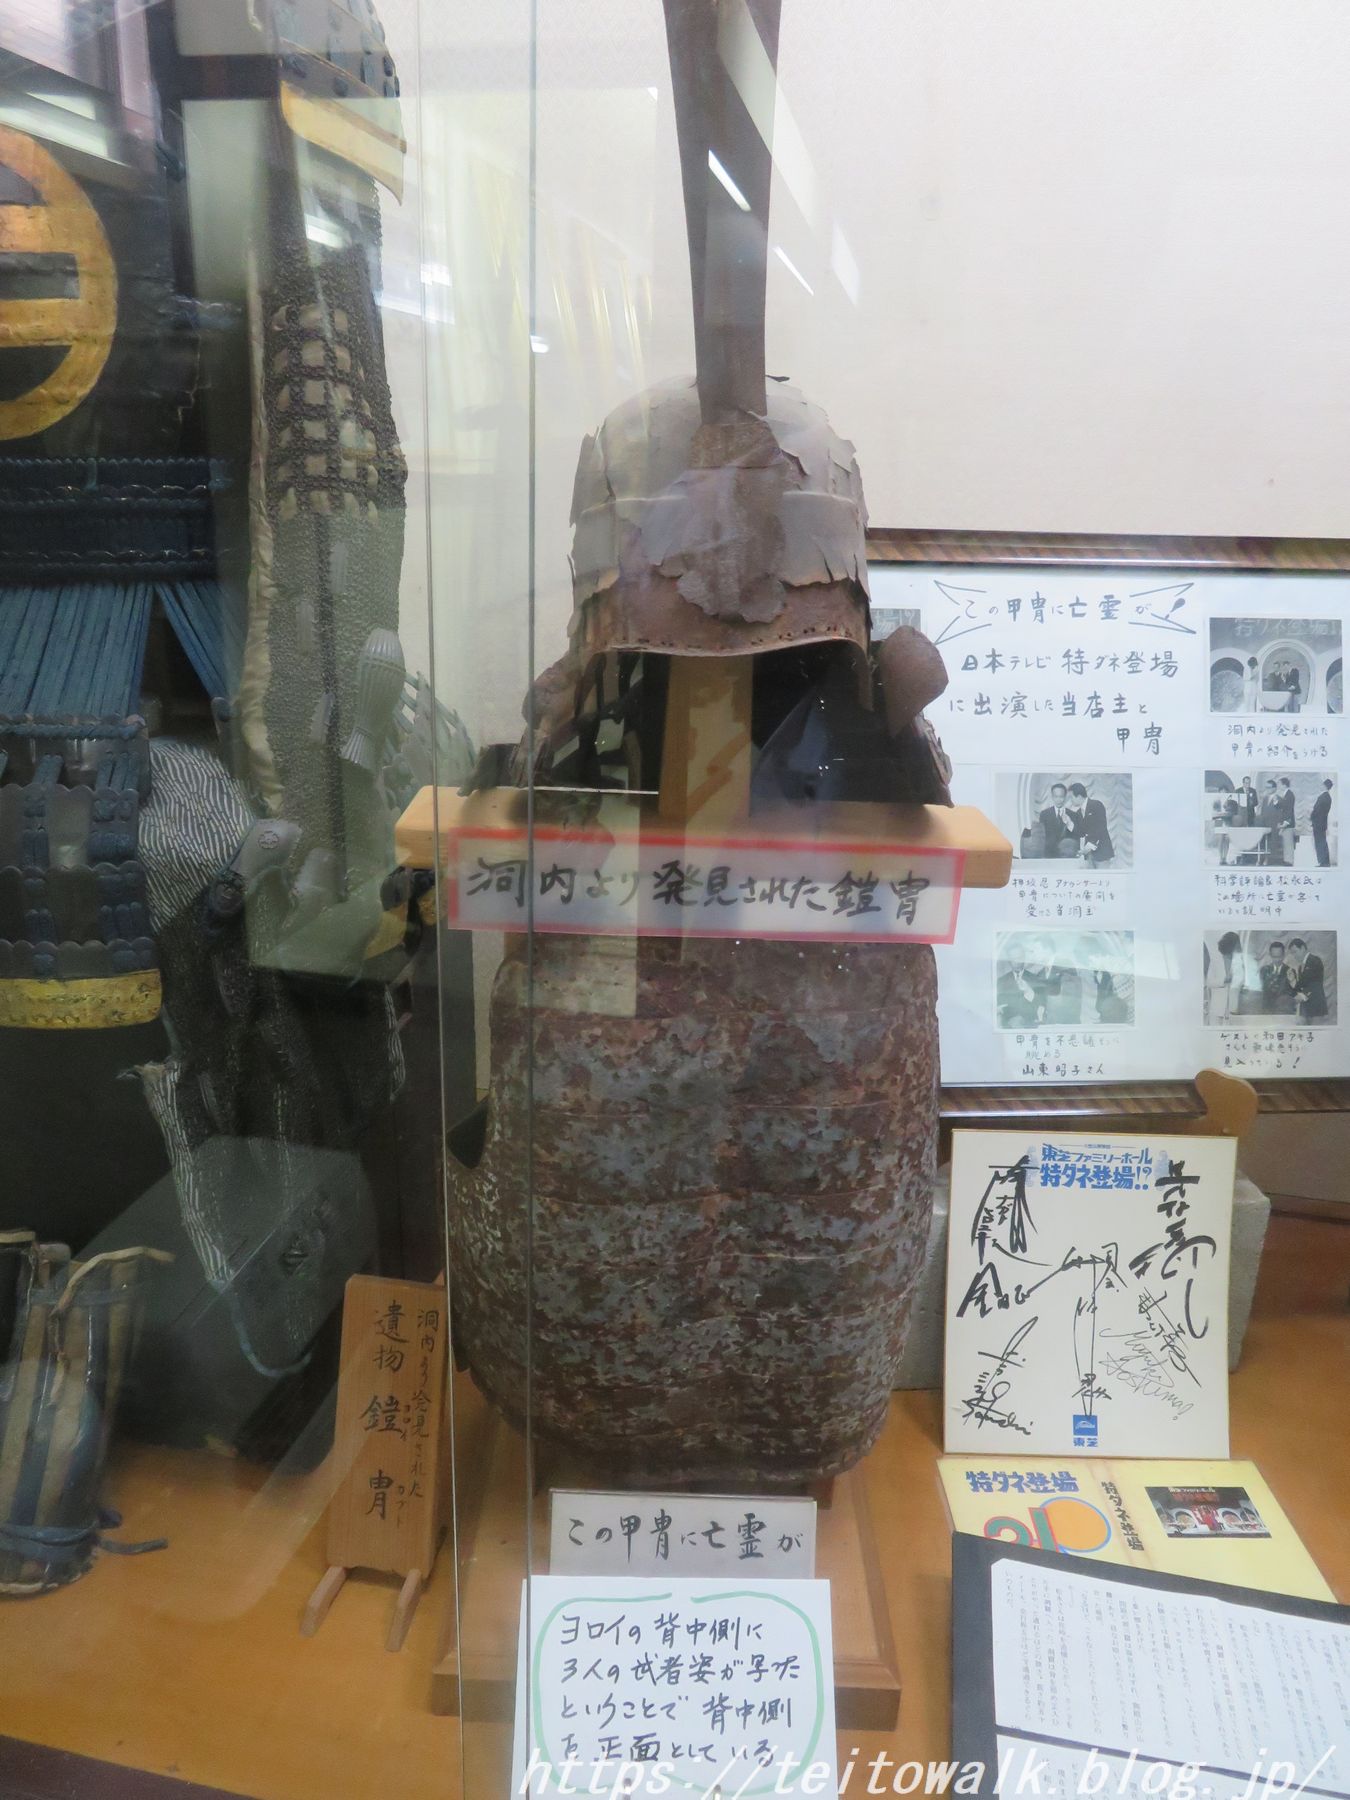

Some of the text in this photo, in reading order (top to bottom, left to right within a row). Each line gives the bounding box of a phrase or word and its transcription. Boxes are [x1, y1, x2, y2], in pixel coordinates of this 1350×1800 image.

[1115, 721, 1164, 756] 甲冑
[1041, 1143, 1153, 1165] 東芝ファミリーホール
[1040, 1163, 1153, 1190] 特ダネ登場!?
[567, 1508, 803, 1563] この甲冑に亡霊が
